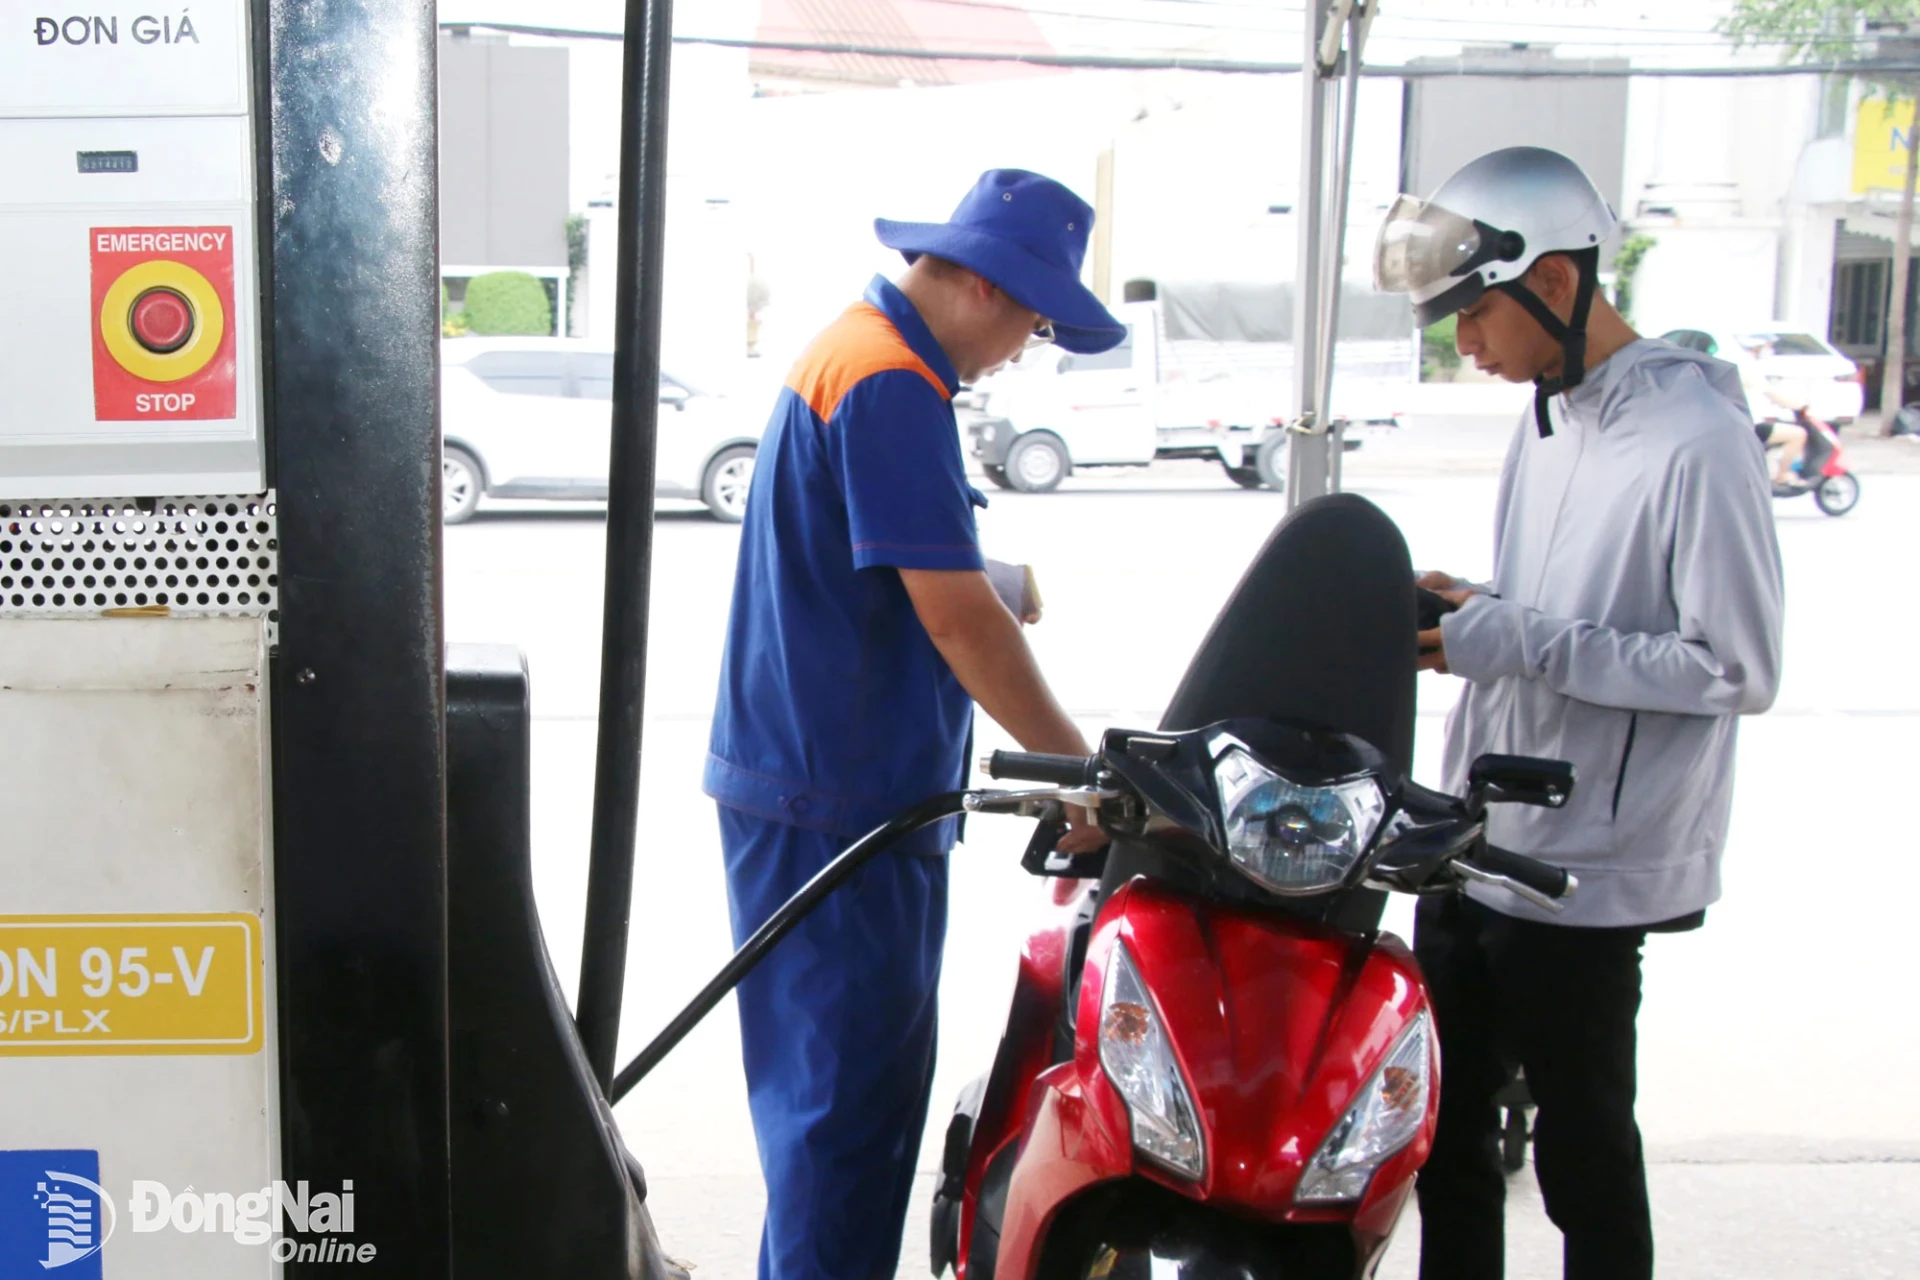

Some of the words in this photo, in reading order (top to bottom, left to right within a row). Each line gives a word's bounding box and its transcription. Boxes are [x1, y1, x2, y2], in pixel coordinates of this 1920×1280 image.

[33, 15, 118, 45] ĐƠN
[131, 8, 200, 44] GIÁ
[96, 233, 226, 252] EMERGENCY
[135, 394, 196, 413] STOP
[79, 946, 215, 998] 95-V
[0, 1009, 112, 1034] /PLX
